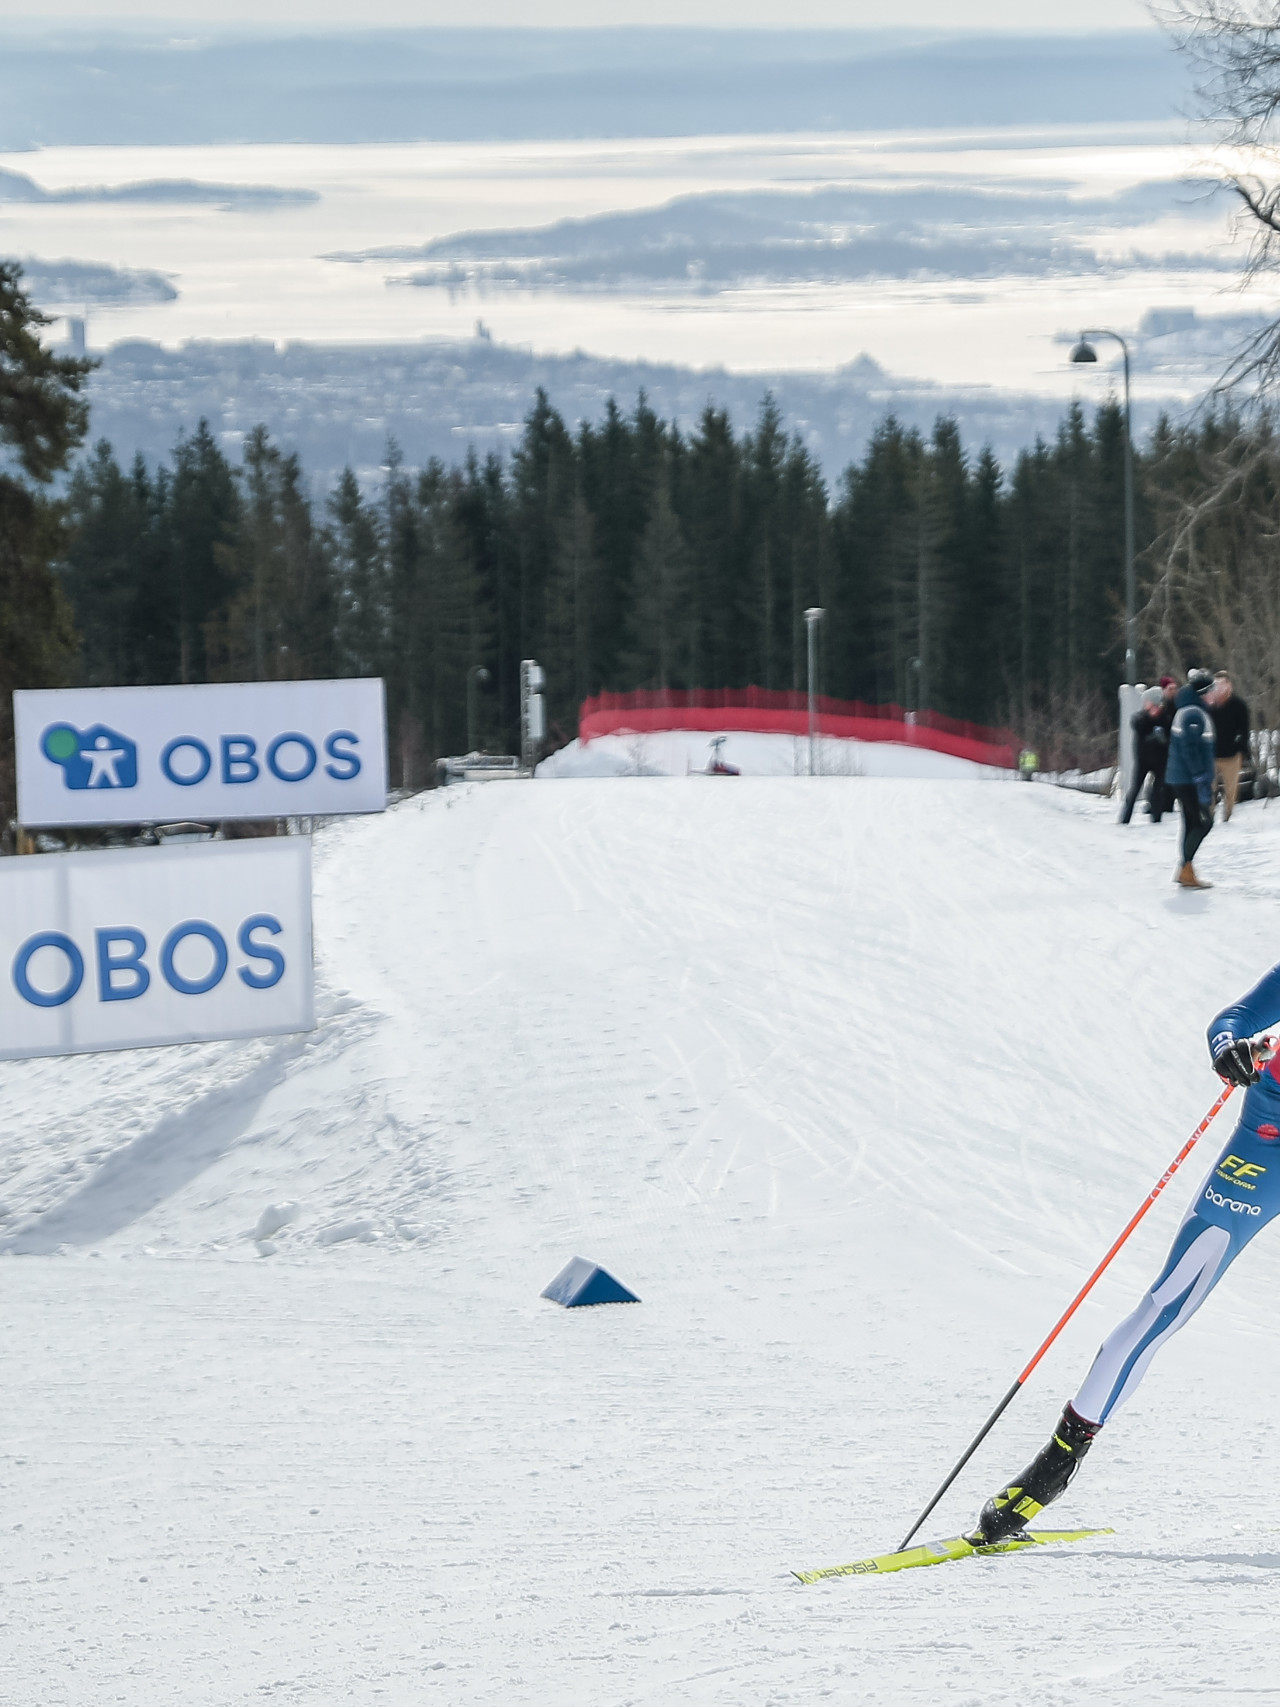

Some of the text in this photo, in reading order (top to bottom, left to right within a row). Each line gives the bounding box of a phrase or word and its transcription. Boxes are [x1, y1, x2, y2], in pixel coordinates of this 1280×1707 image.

[160, 729, 361, 786] OBOS
[12, 912, 285, 1007] OBOS
[1219, 1154, 1267, 1177] FF
[816, 1559, 879, 1579] FISCHER
